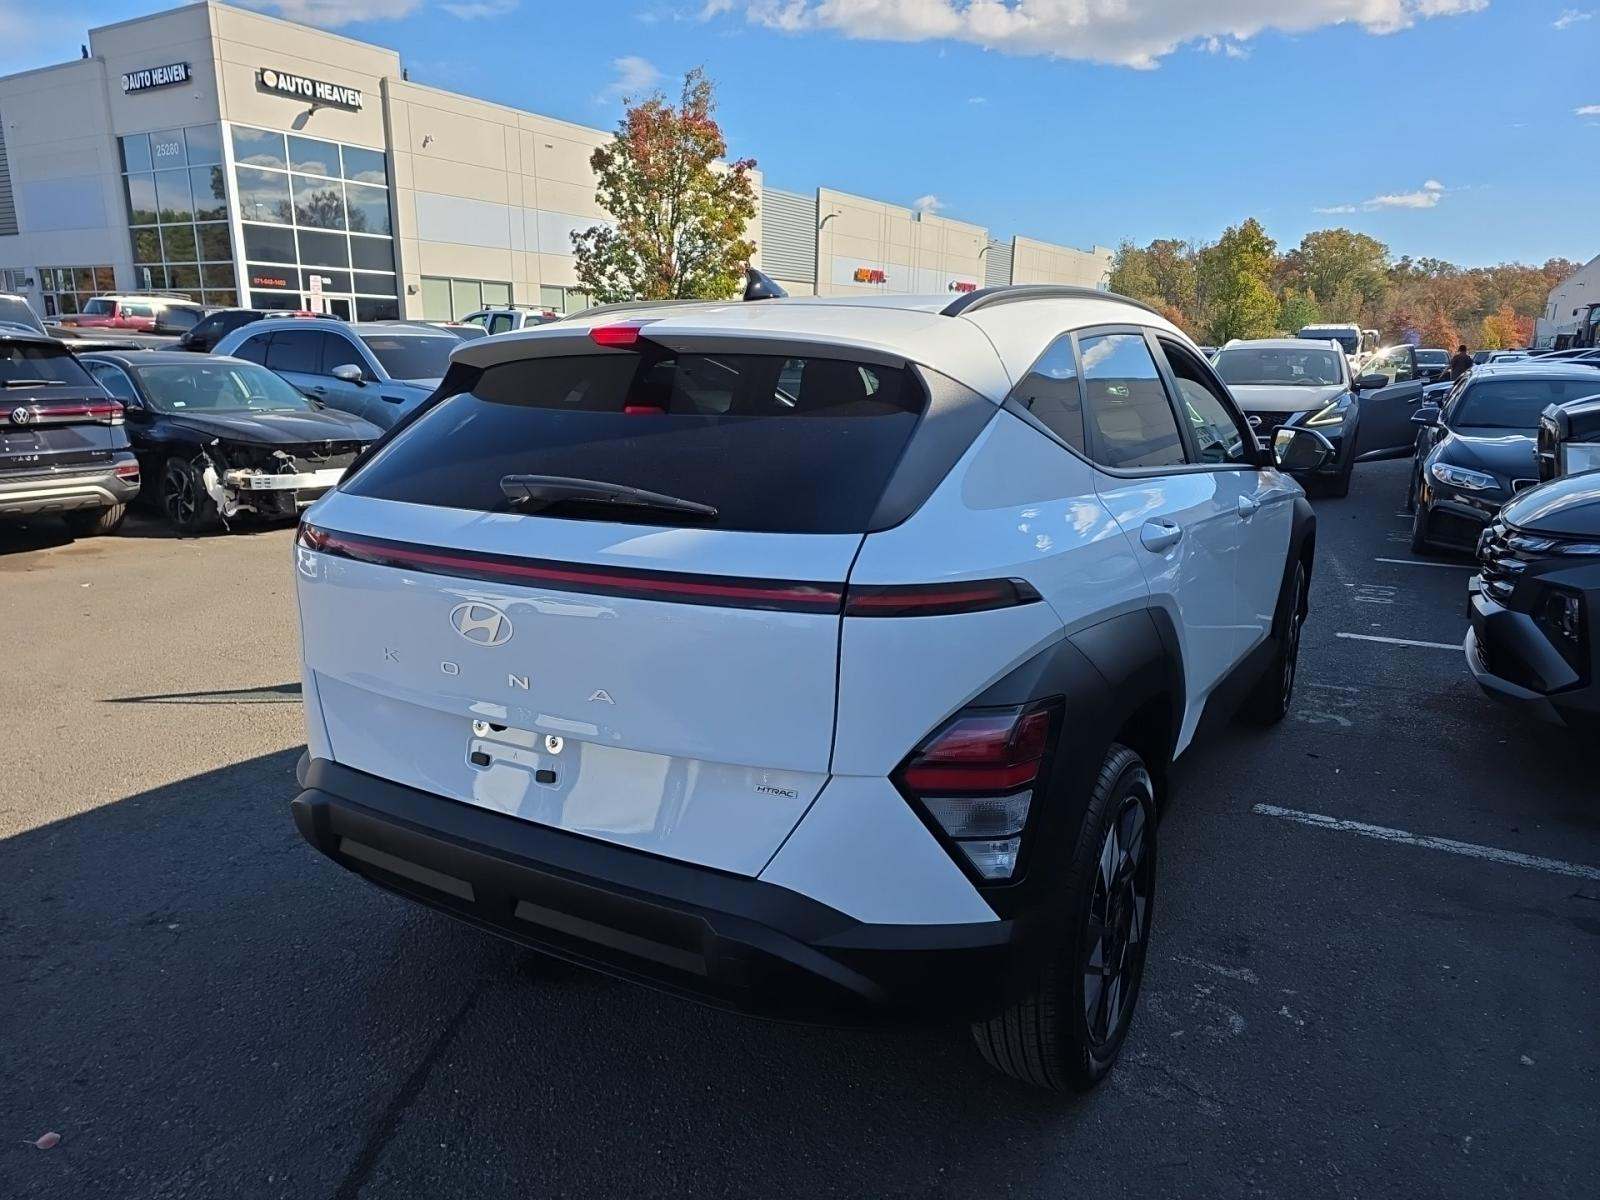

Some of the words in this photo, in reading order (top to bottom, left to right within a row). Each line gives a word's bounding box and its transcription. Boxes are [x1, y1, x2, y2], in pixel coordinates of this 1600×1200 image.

[129, 71, 151, 90] AUTO
[152, 64, 186, 86] HEAVEN
[278, 74, 313, 96] AUTO
[315, 82, 362, 106] HEAVEN
[384, 647, 616, 705] KONA
[756, 786, 794, 798] HTRAC
